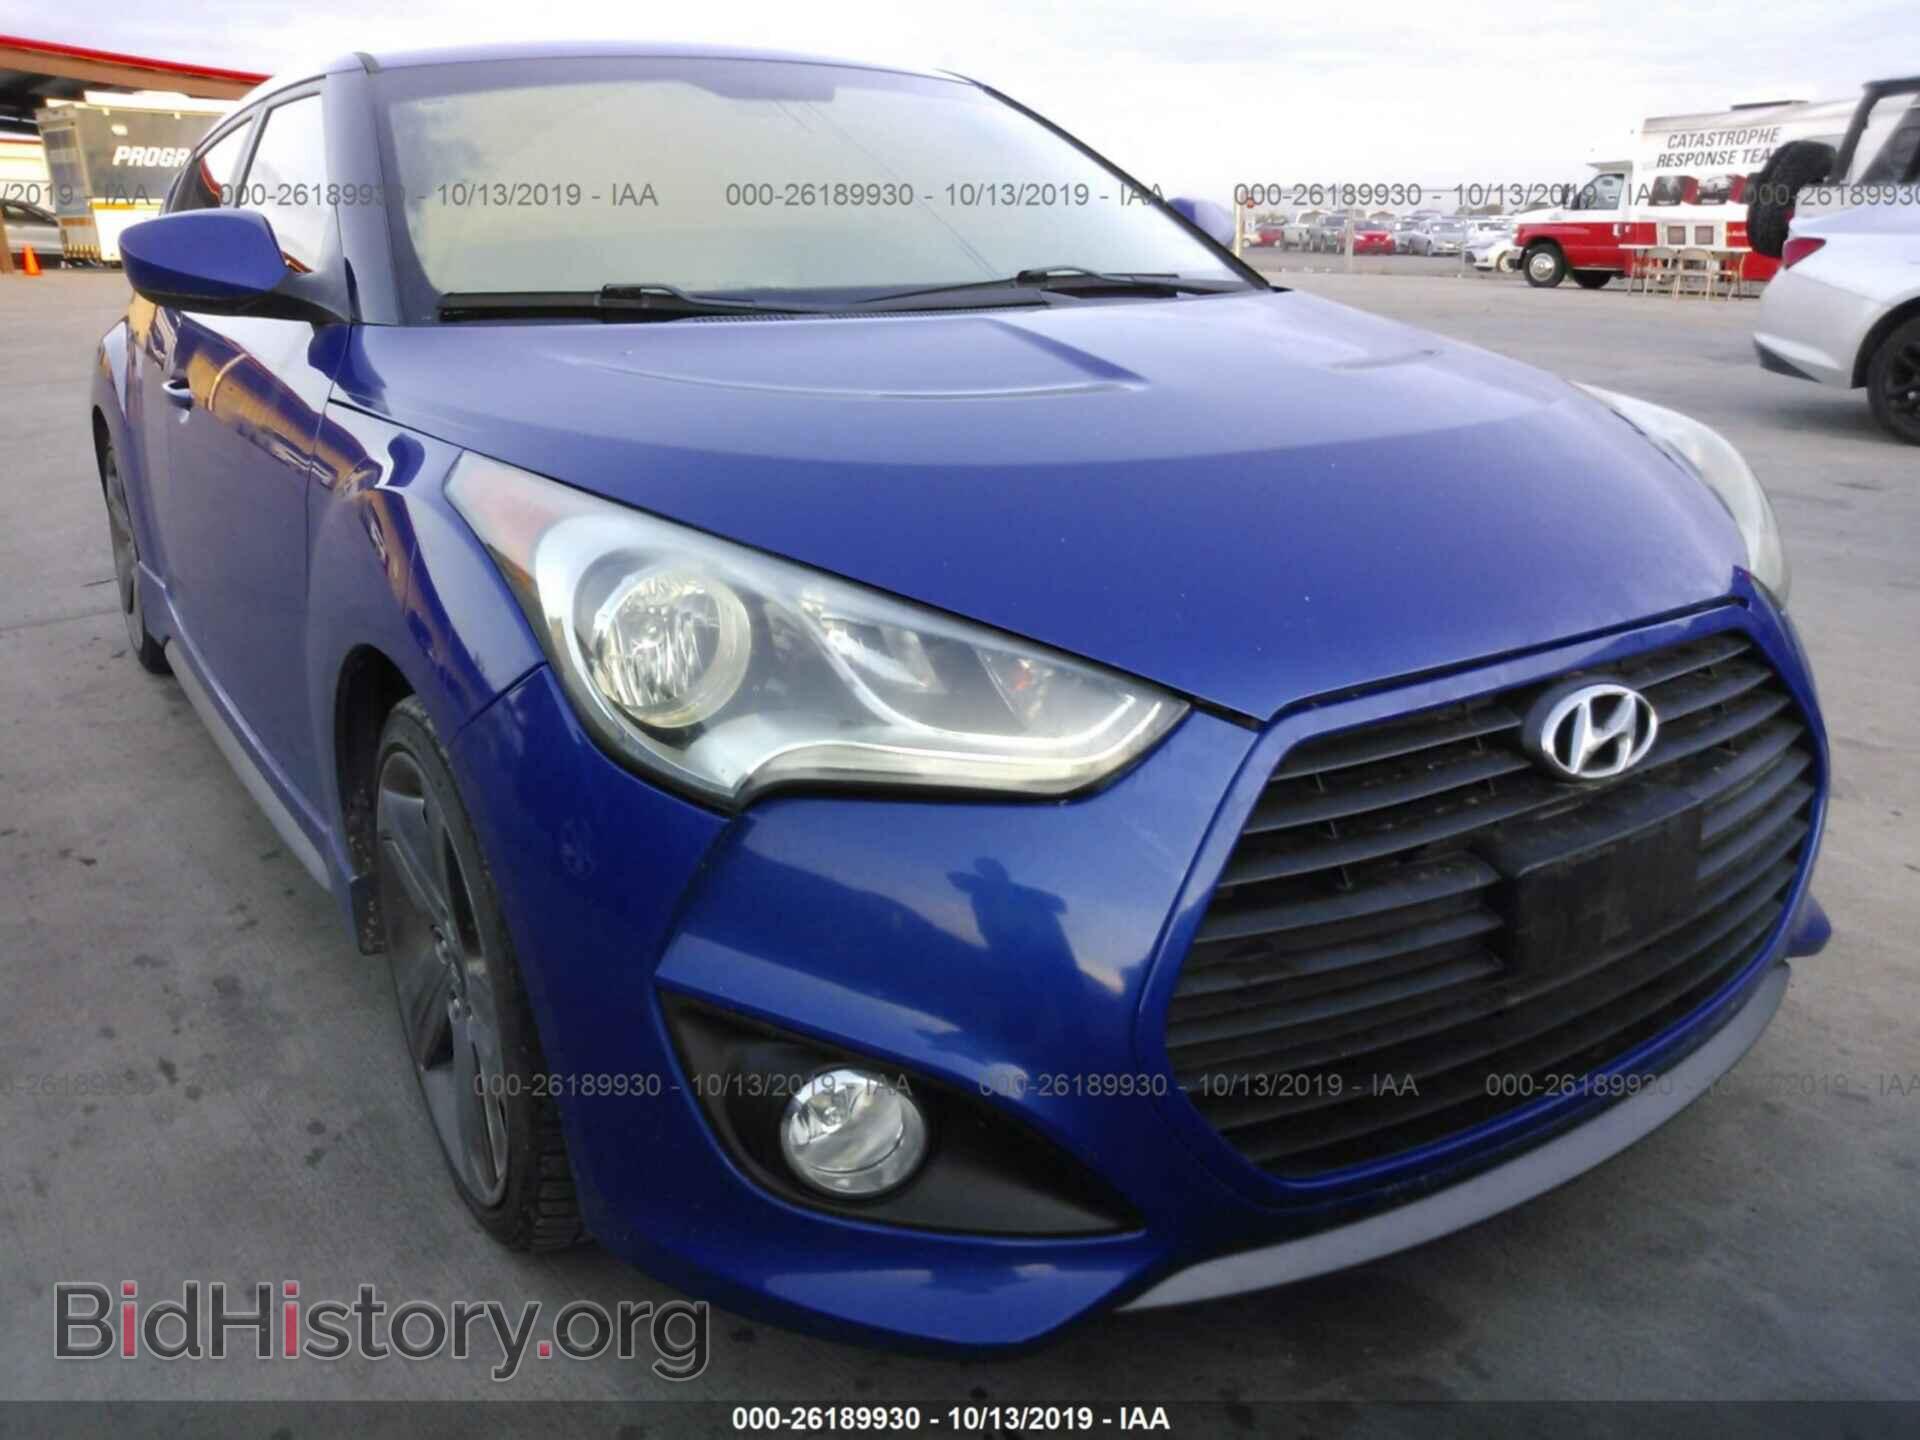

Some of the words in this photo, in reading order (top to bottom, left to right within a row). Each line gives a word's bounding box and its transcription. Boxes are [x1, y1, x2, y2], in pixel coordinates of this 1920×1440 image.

[1667, 127, 1781, 149] CATASTROPHE
[1656, 150, 1737, 168] RESPONSE
[1742, 148, 1774, 164] TEA
